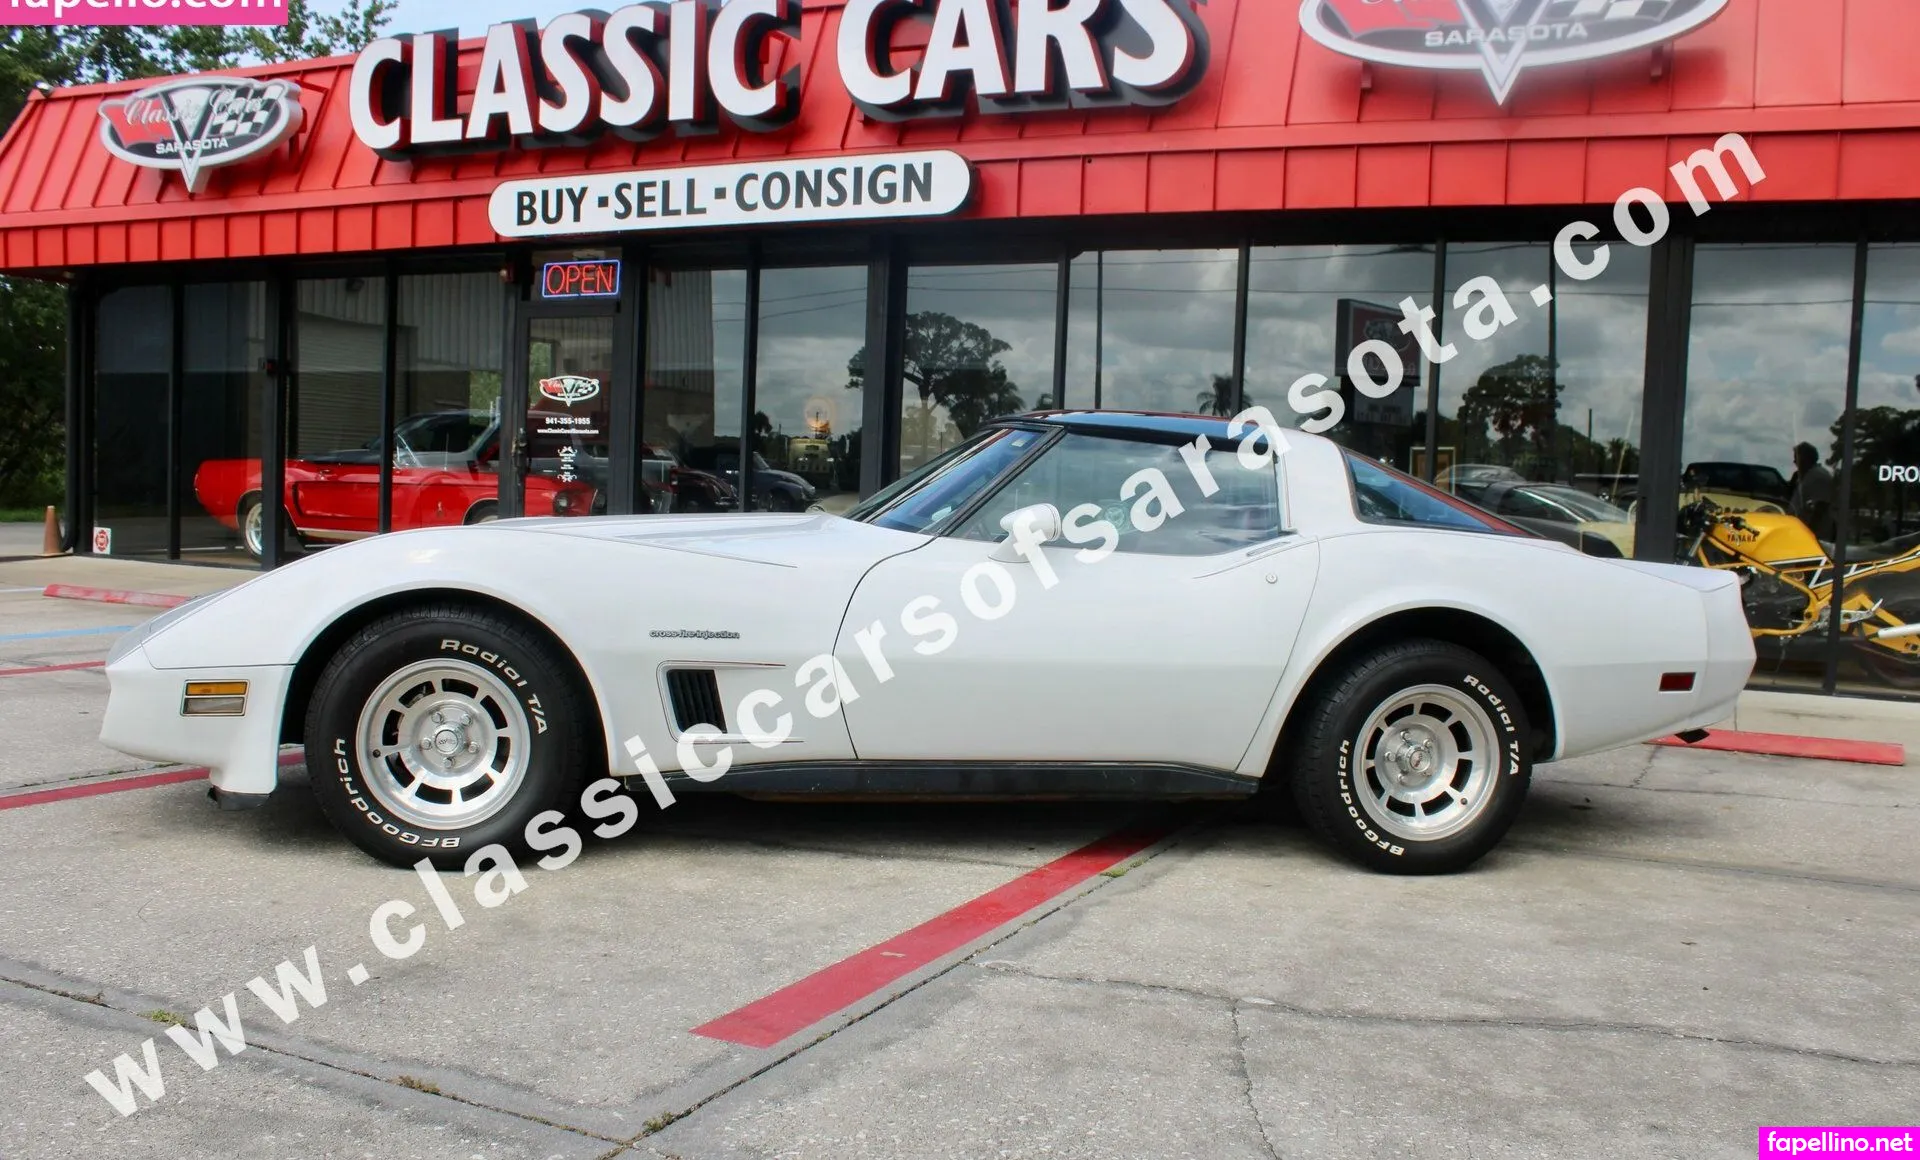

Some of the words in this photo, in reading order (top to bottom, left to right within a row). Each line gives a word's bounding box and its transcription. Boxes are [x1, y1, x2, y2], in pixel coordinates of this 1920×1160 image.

[349, 0, 777, 149] CLASSIC
[837, 0, 1187, 104] CARS
[1424, 22, 1588, 47] SARASOTA
[155, 138, 229, 155] SARASOTA
[516, 186, 588, 226] BUY
[614, 178, 706, 219] SELL
[735, 162, 932, 211] CONSIGN
[546, 265, 614, 294] OPEN
[1878, 464, 1920, 482] DRO
[440, 639, 528, 687] Radial
[528, 693, 548, 735] T/A
[1463, 674, 1515, 732] Radial
[1509, 740, 1520, 775] T/A
[334, 738, 461, 849] BFGoodrich
[1338, 739, 1405, 856] BFGoodrich
